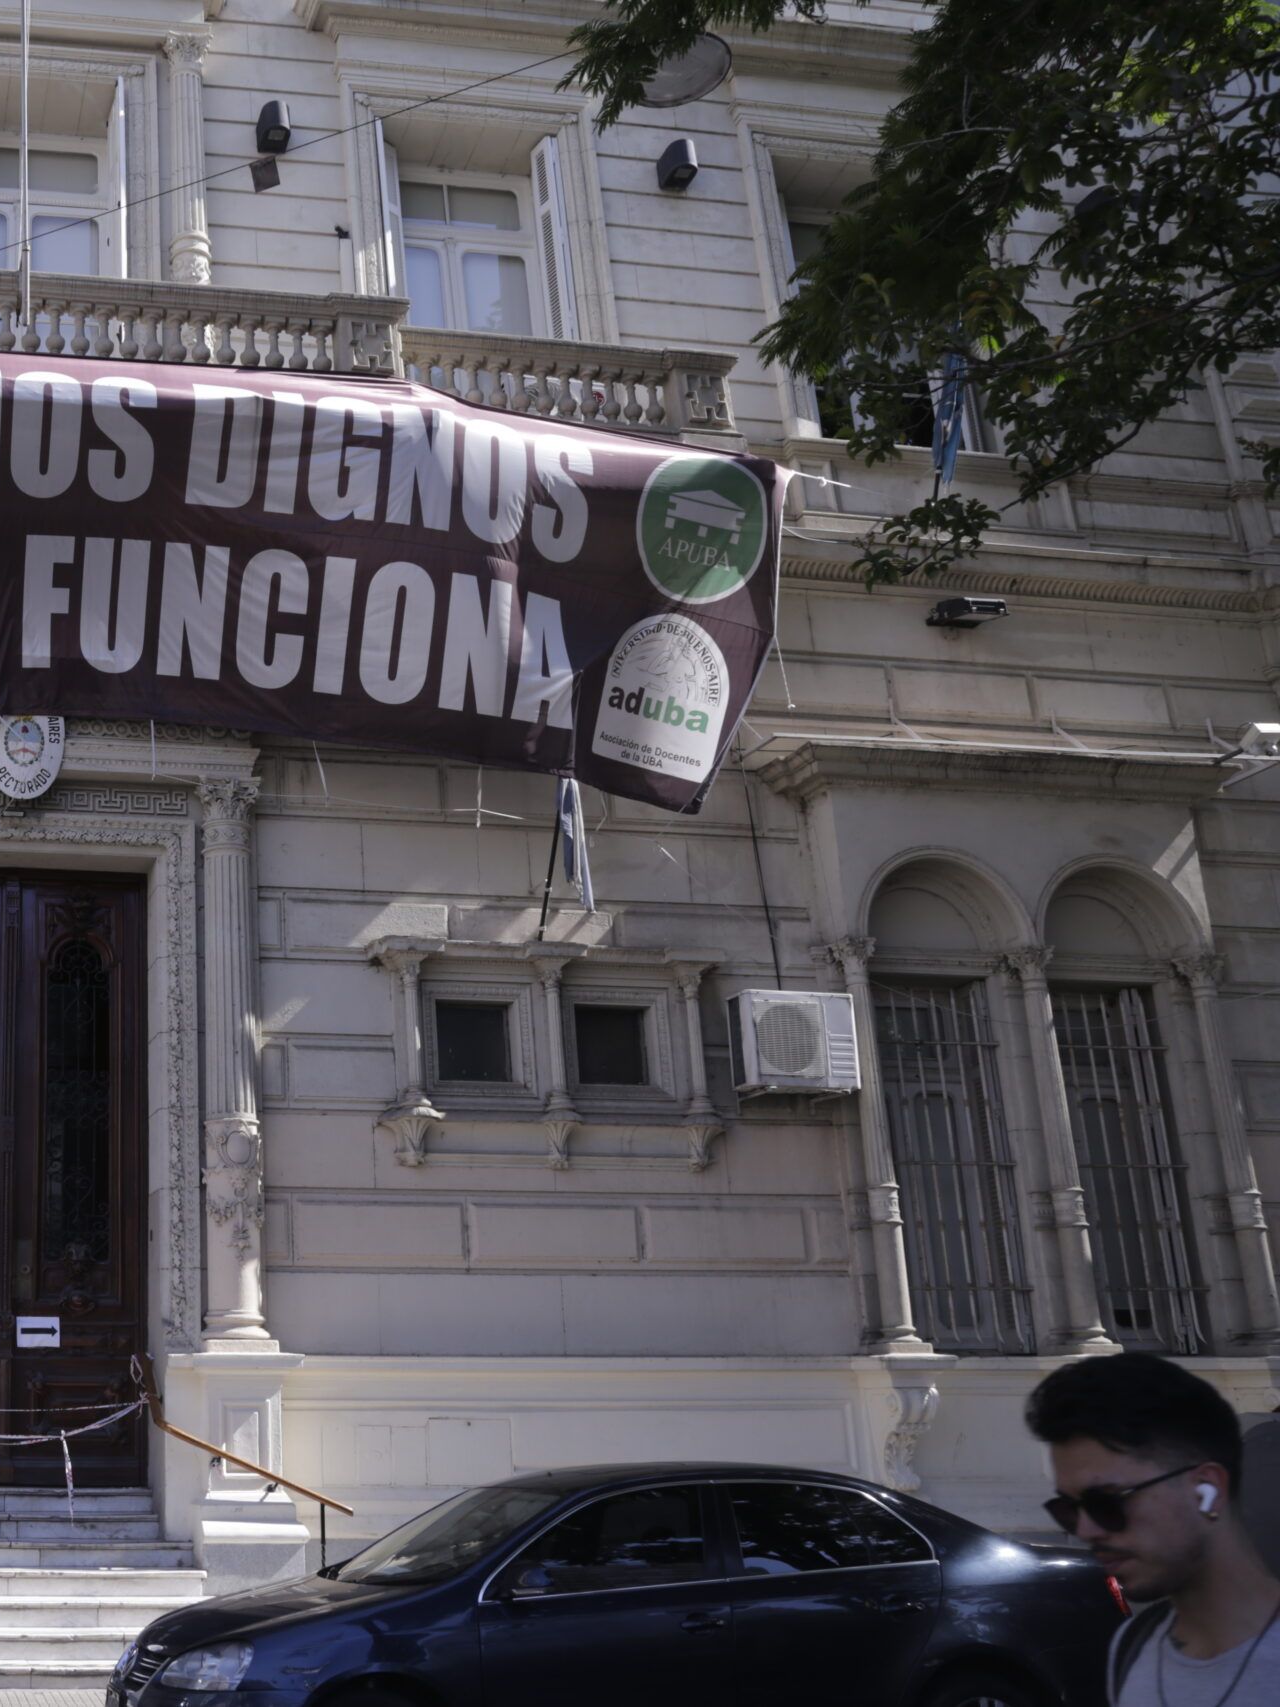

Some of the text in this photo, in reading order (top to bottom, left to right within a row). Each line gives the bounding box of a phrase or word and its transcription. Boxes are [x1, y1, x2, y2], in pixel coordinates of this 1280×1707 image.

[184, 383, 594, 563] DIGNOS
[657, 536, 731, 572] APUBA
[21, 534, 574, 730] FUNCIONA
[608, 685, 710, 734] aduba
[47, 716, 61, 744] AIRES
[599, 730, 701, 767] Asociación de Docentes
[620, 748, 663, 769] de la UBA
